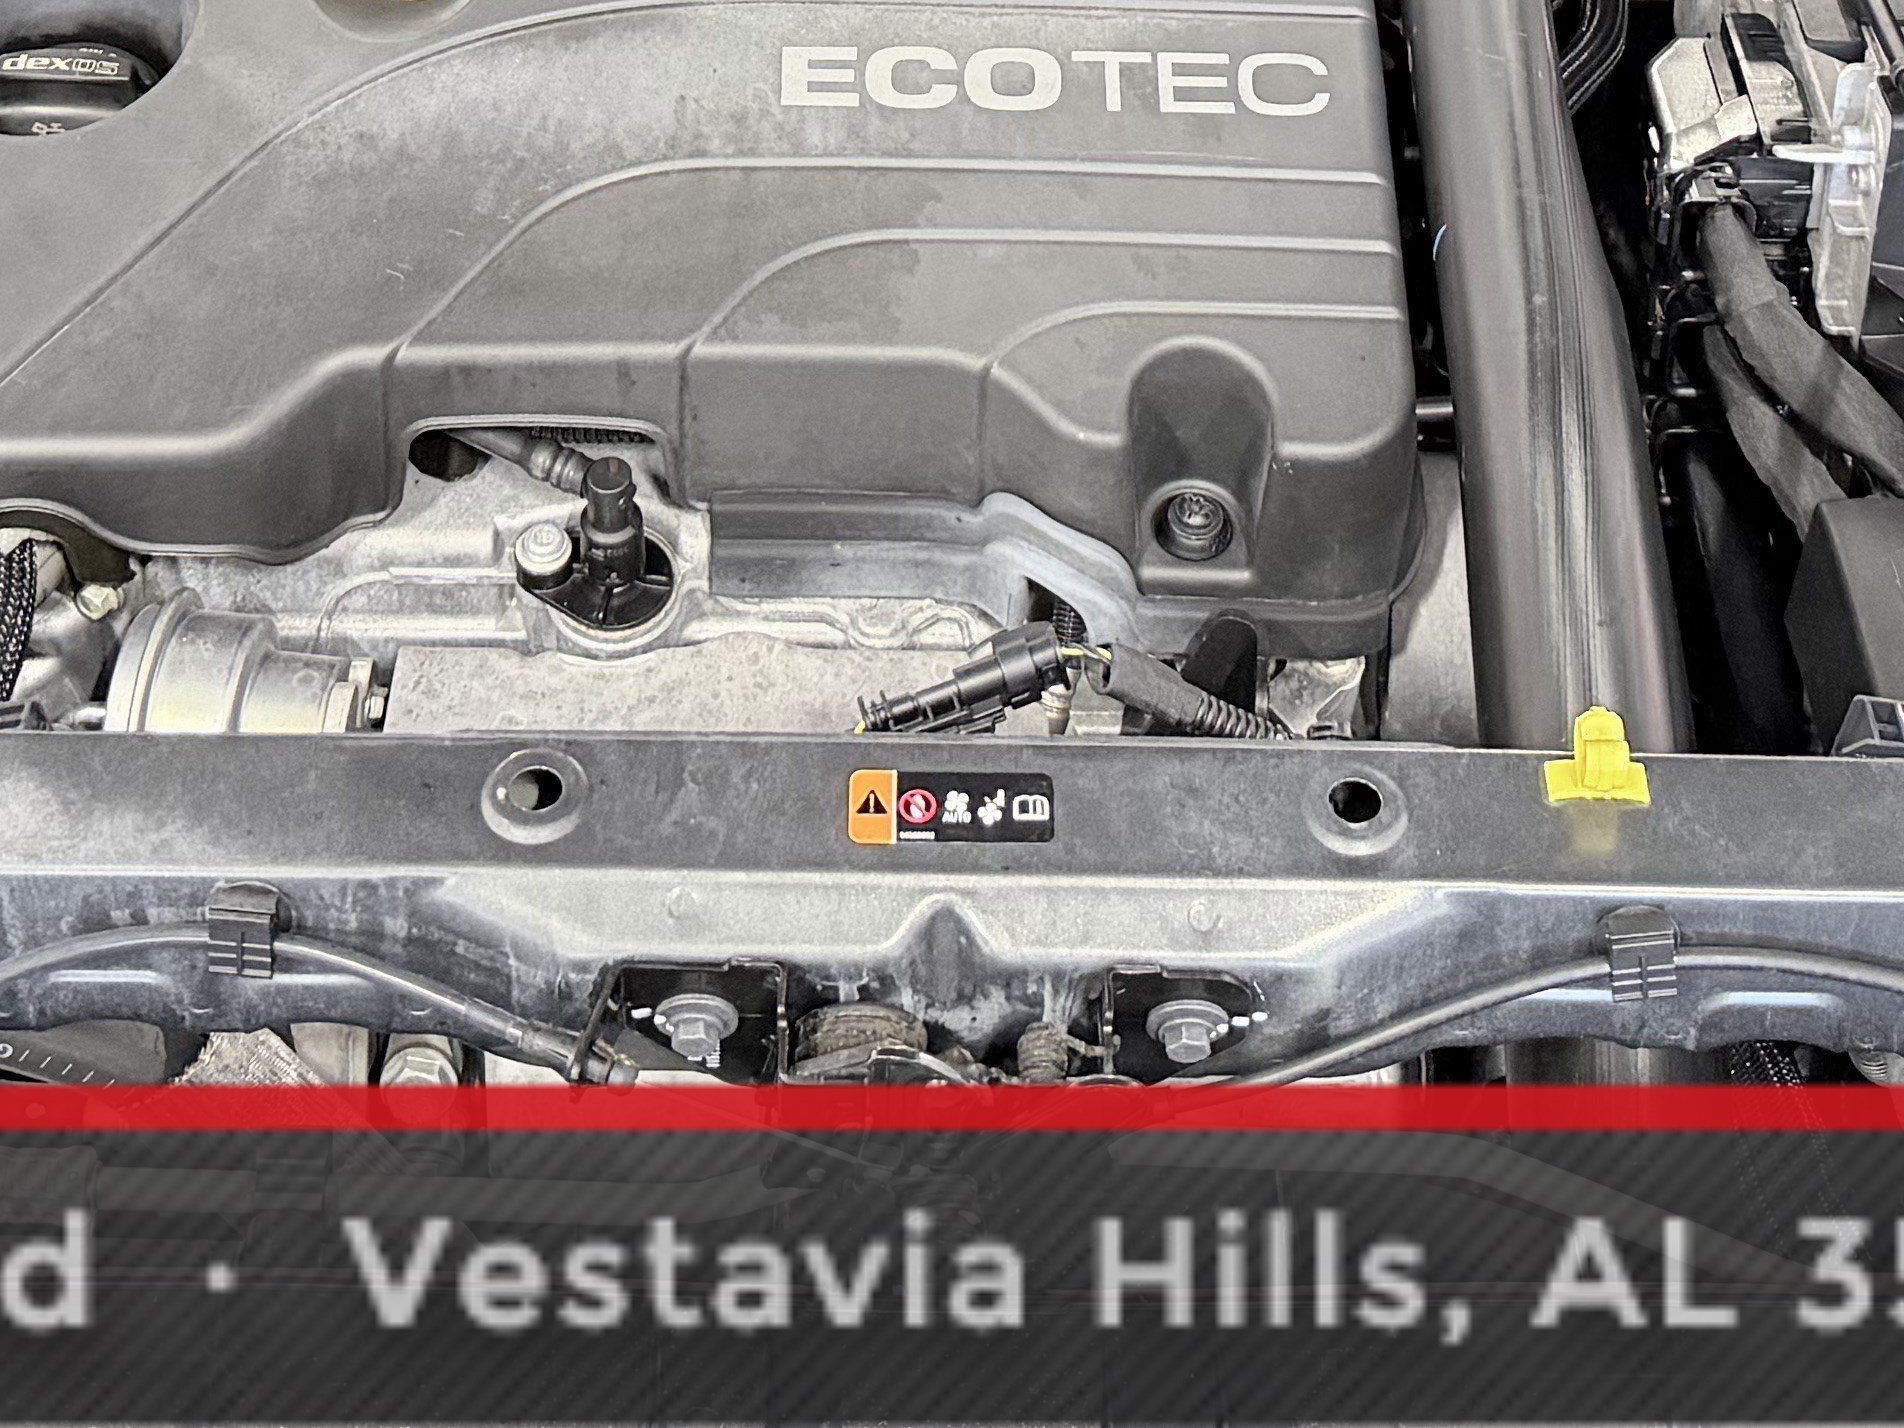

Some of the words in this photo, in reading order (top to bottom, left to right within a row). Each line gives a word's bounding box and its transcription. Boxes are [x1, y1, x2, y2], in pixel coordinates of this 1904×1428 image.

[2, 54, 120, 76] dexos
[780, 45, 1331, 117] ECOTEC
[942, 811, 972, 824] AUTO
